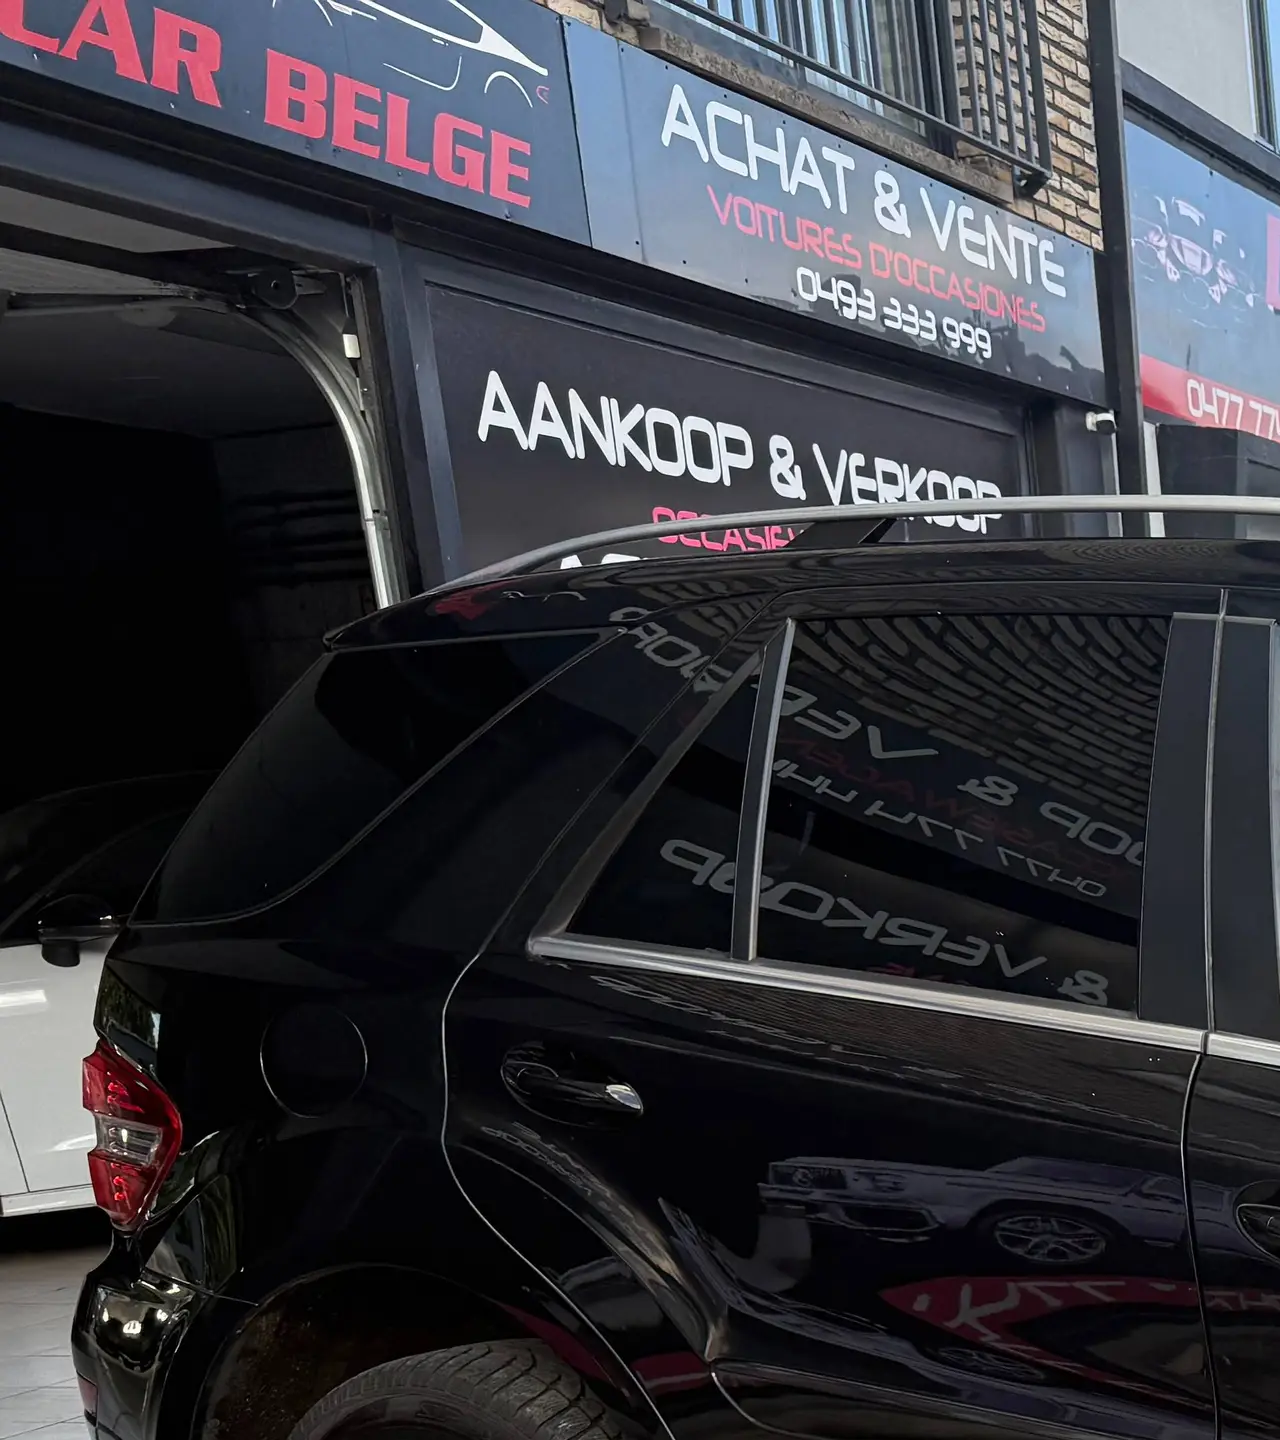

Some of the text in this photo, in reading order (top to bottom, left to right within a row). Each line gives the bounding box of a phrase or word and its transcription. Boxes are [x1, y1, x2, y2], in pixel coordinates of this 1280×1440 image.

[264, 48, 532, 208] BELGE
[661, 83, 1068, 299] ACHAT & VENTE
[706, 184, 1046, 333] VOITURES D'OCCASIONES
[796, 265, 992, 359] 0493 333 999
[477, 369, 1002, 534] AANKOOP & VERKOOP
[1186, 378, 1244, 431] 0477
